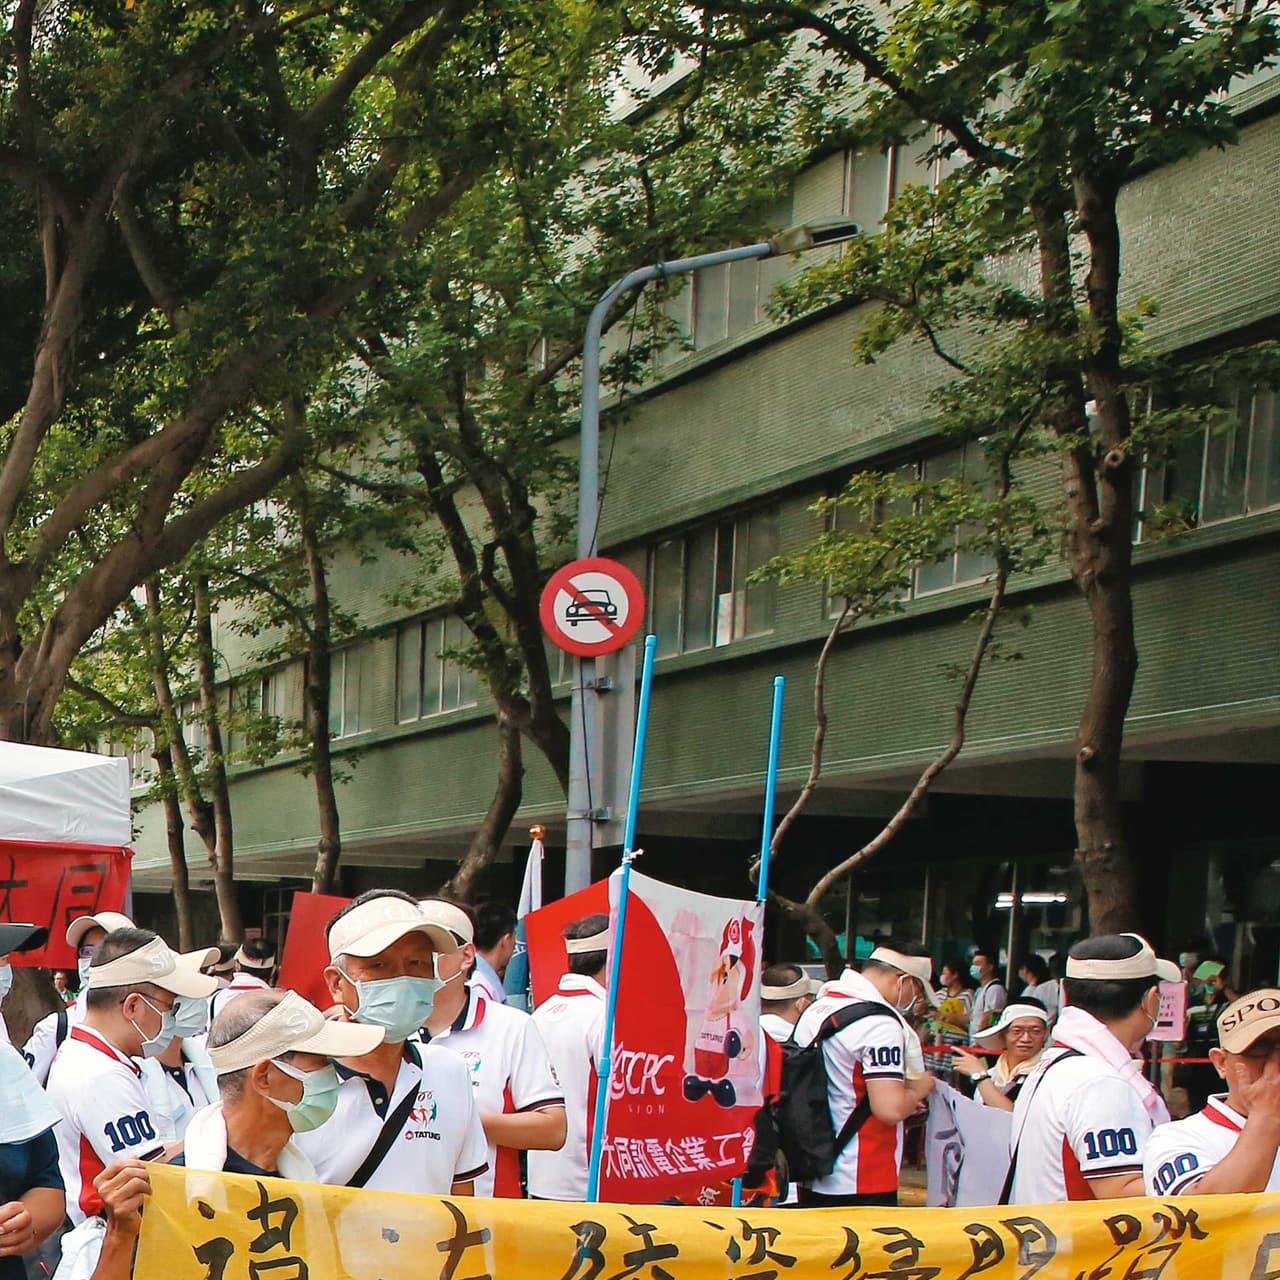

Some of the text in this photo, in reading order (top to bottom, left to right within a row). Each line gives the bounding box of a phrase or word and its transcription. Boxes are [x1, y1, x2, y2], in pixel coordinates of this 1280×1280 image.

[870, 1046, 901, 1067] 100
[104, 1110, 156, 1152] 100
[1083, 1128, 1137, 1160] 100
[1153, 1152, 1199, 1196] 100
